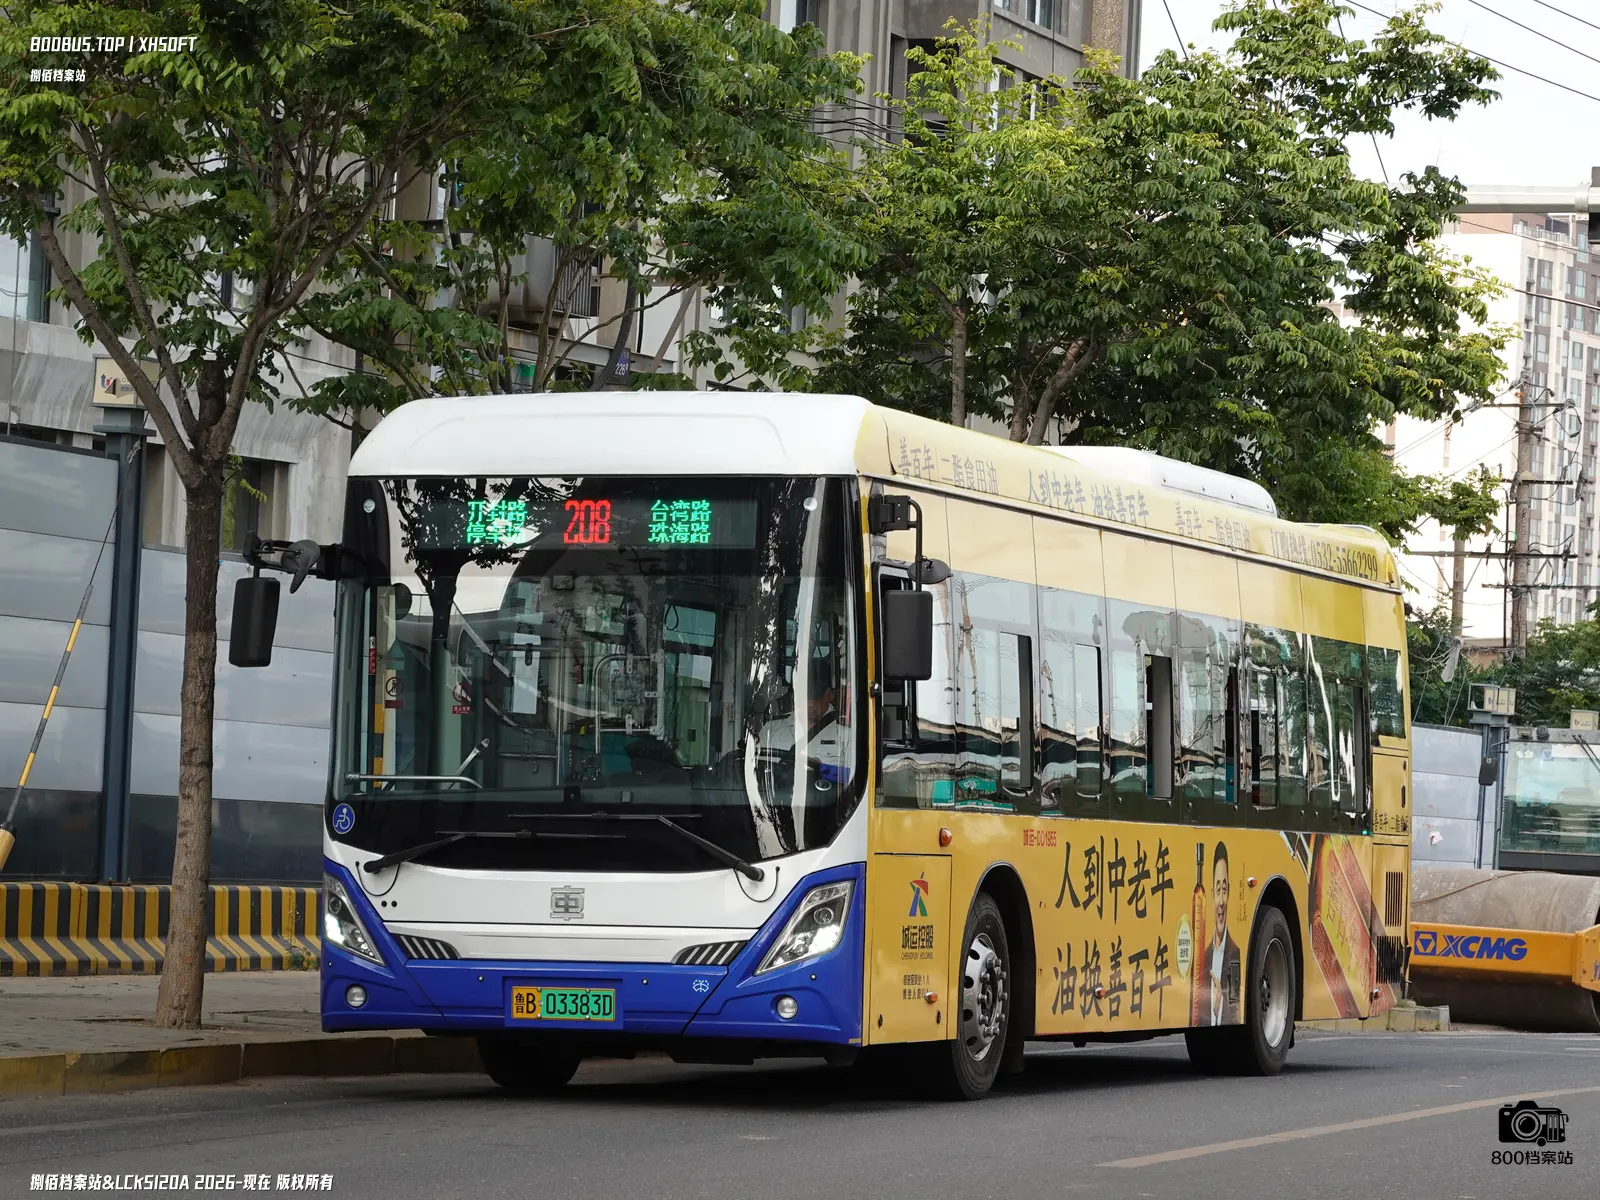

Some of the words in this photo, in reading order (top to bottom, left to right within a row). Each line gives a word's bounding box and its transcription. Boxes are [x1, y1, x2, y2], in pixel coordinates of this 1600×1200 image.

[650, 500, 711, 522] 台湾路
[1027, 469, 1087, 518] 人到中老年
[1090, 484, 1150, 530] 油换善百年
[564, 500, 611, 544] 208
[648, 523, 711, 544] 珠海路
[1055, 834, 1174, 925] 人到中老年
[901, 925, 934, 950] 城运控股
[1437, 935, 1528, 961] XCMG
[1051, 935, 1173, 1022] 油换善百年
[515, 992, 536, 1014] 鲁B
[546, 993, 612, 1016] 03383D
